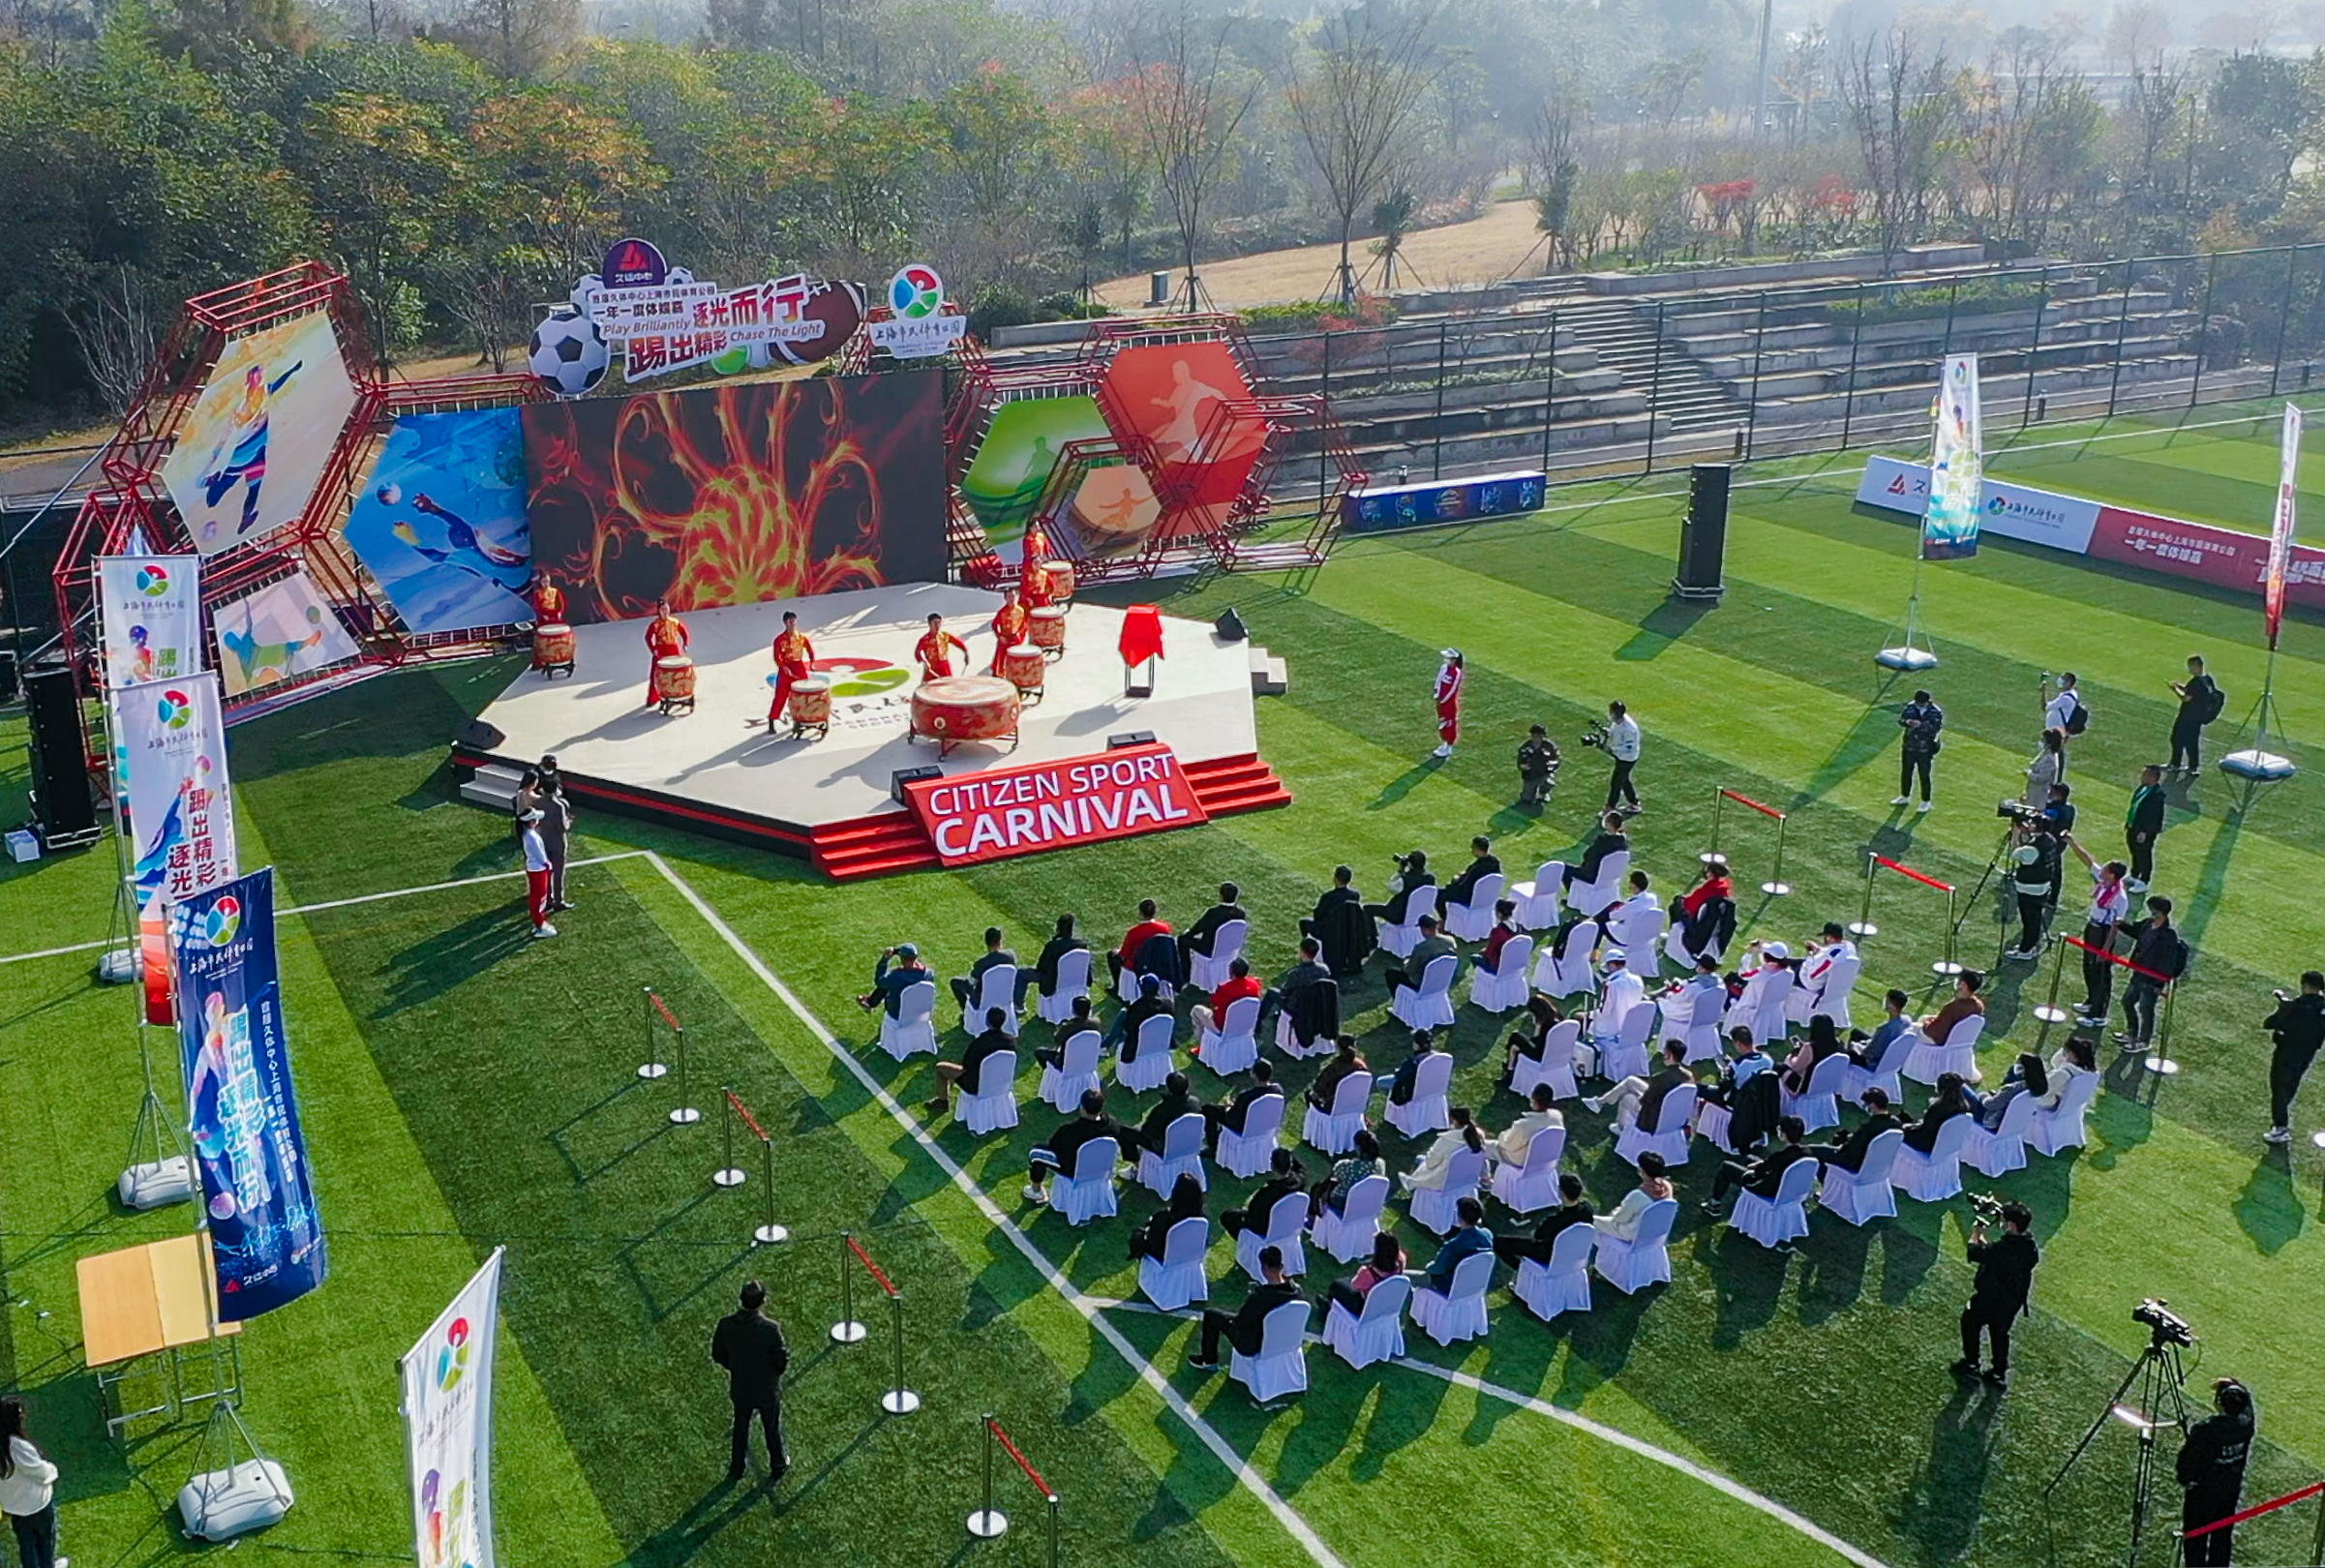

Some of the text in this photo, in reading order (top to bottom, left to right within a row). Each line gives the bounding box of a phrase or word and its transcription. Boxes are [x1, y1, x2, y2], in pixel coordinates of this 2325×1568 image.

[603, 318, 691, 336] Play Brilliantly
[693, 277, 804, 329] 逐光而行
[629, 330, 727, 377] 踢出精彩
[730, 323, 821, 342] Chase The Light
[929, 751, 1174, 816] CITIZEN SPORT
[189, 787, 217, 887] 踢出精彩
[933, 782, 1189, 858] CARNIVAL
[167, 844, 196, 900] 逐光
